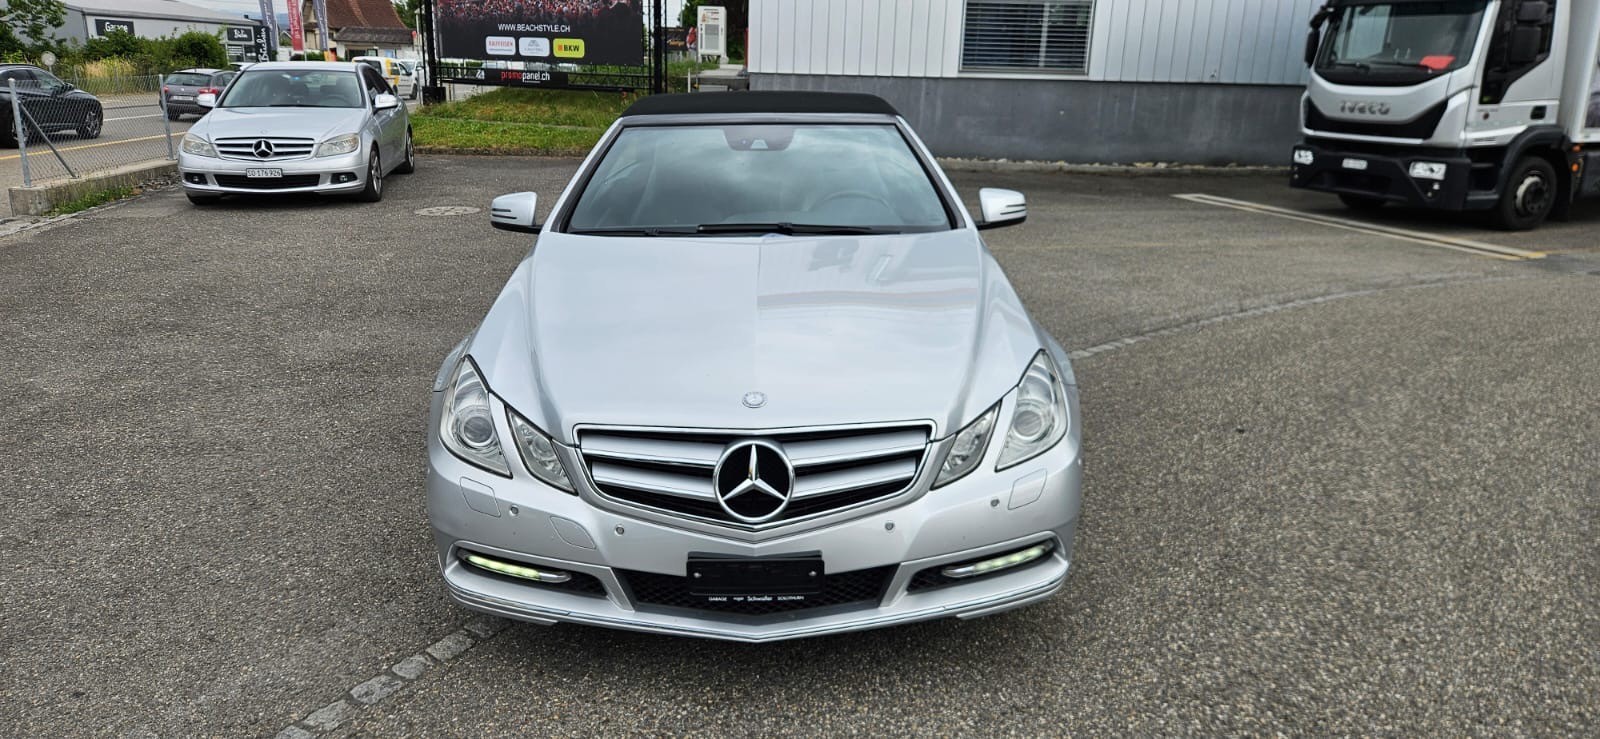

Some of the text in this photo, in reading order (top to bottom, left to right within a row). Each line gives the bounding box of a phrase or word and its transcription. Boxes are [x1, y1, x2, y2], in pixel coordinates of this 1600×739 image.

[497, 23, 571, 33] WWW.BEACHSTYLE.CH
[563, 44, 580, 52] BKW
[501, 71, 551, 83] promopanel.ch
[1340, 100, 1391, 116] IVECO
